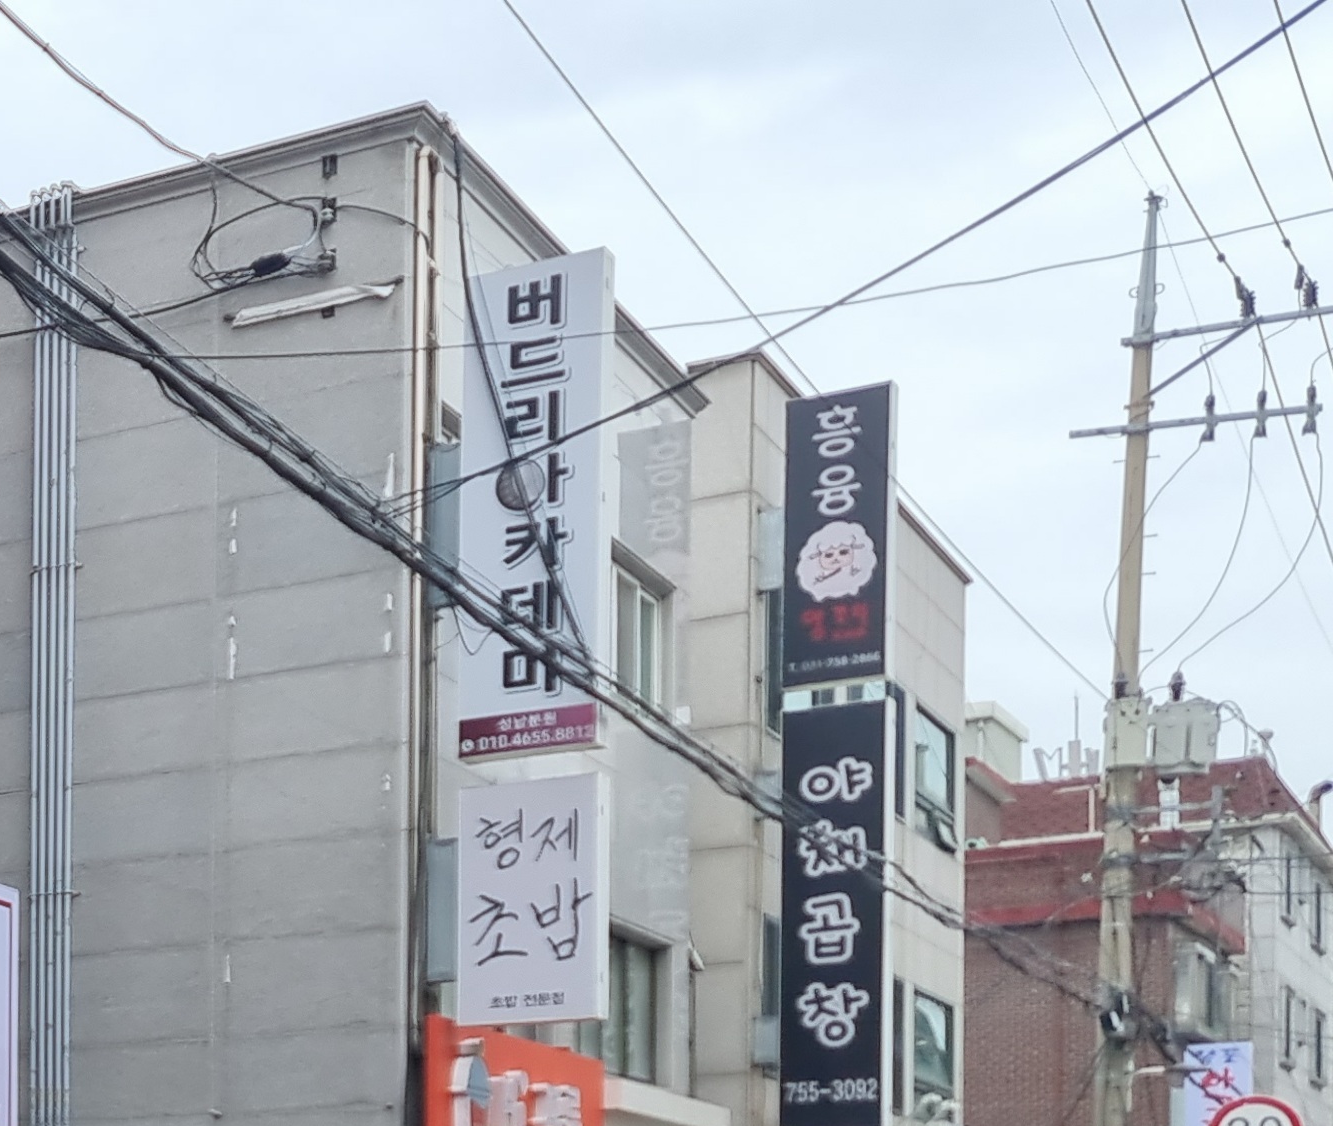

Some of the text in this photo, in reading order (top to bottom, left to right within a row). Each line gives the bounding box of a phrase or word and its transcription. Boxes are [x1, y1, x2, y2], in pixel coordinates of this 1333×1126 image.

[474, 808, 579, 870] 형제
[468, 878, 593, 967] 초밥
[797, 757, 873, 1047] 야채곱창
[786, 1076, 880, 1105] 755-3092
